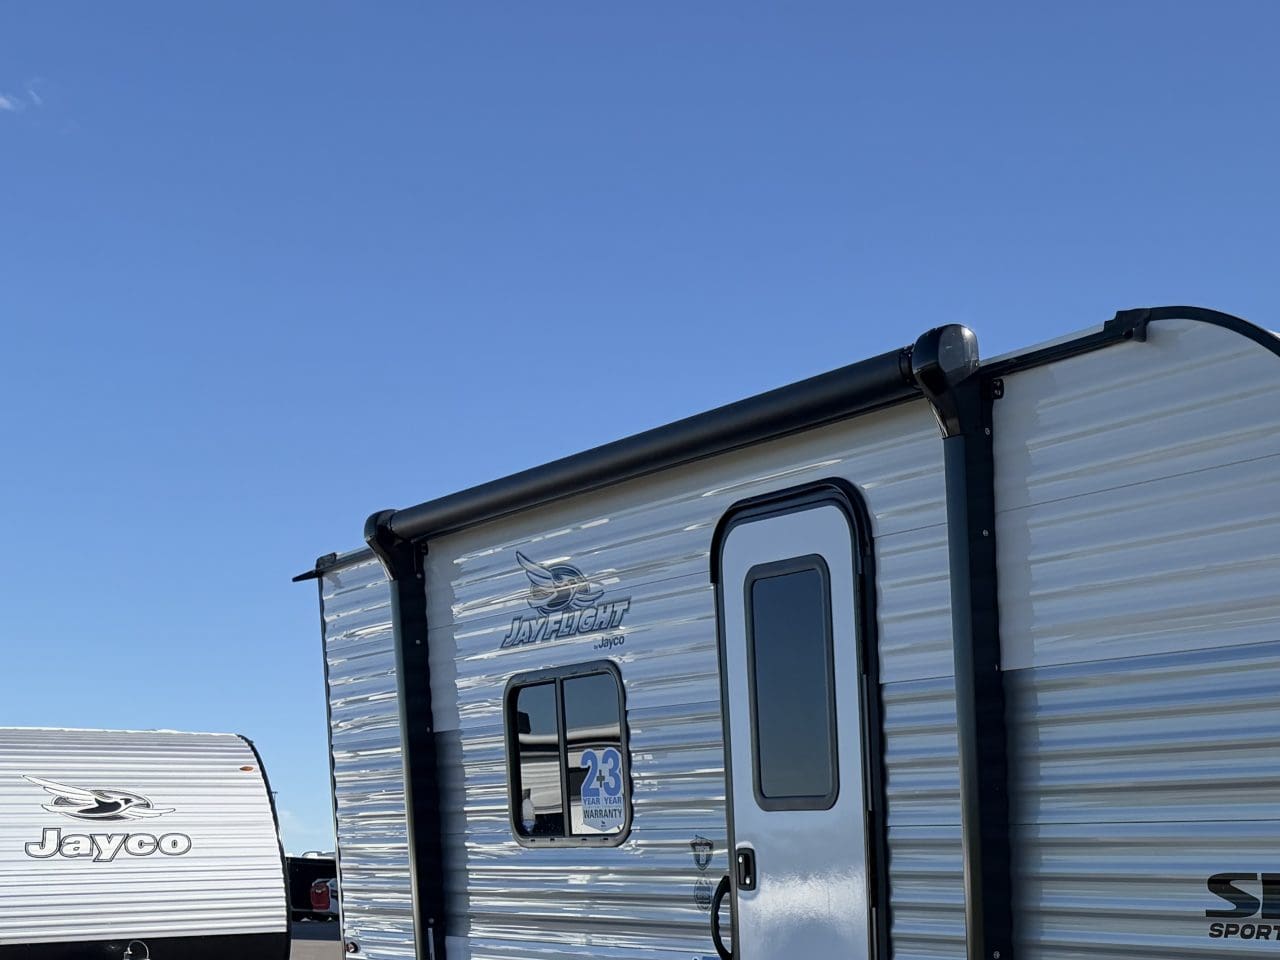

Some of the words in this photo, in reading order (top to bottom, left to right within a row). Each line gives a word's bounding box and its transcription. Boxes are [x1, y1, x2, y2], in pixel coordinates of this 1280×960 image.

[599, 635, 625, 650] Jayco
[583, 797, 600, 805] YEAR
[604, 796, 622, 804] YEAR
[584, 808, 623, 819] WARRANTY
[25, 827, 192, 862] Jayco
